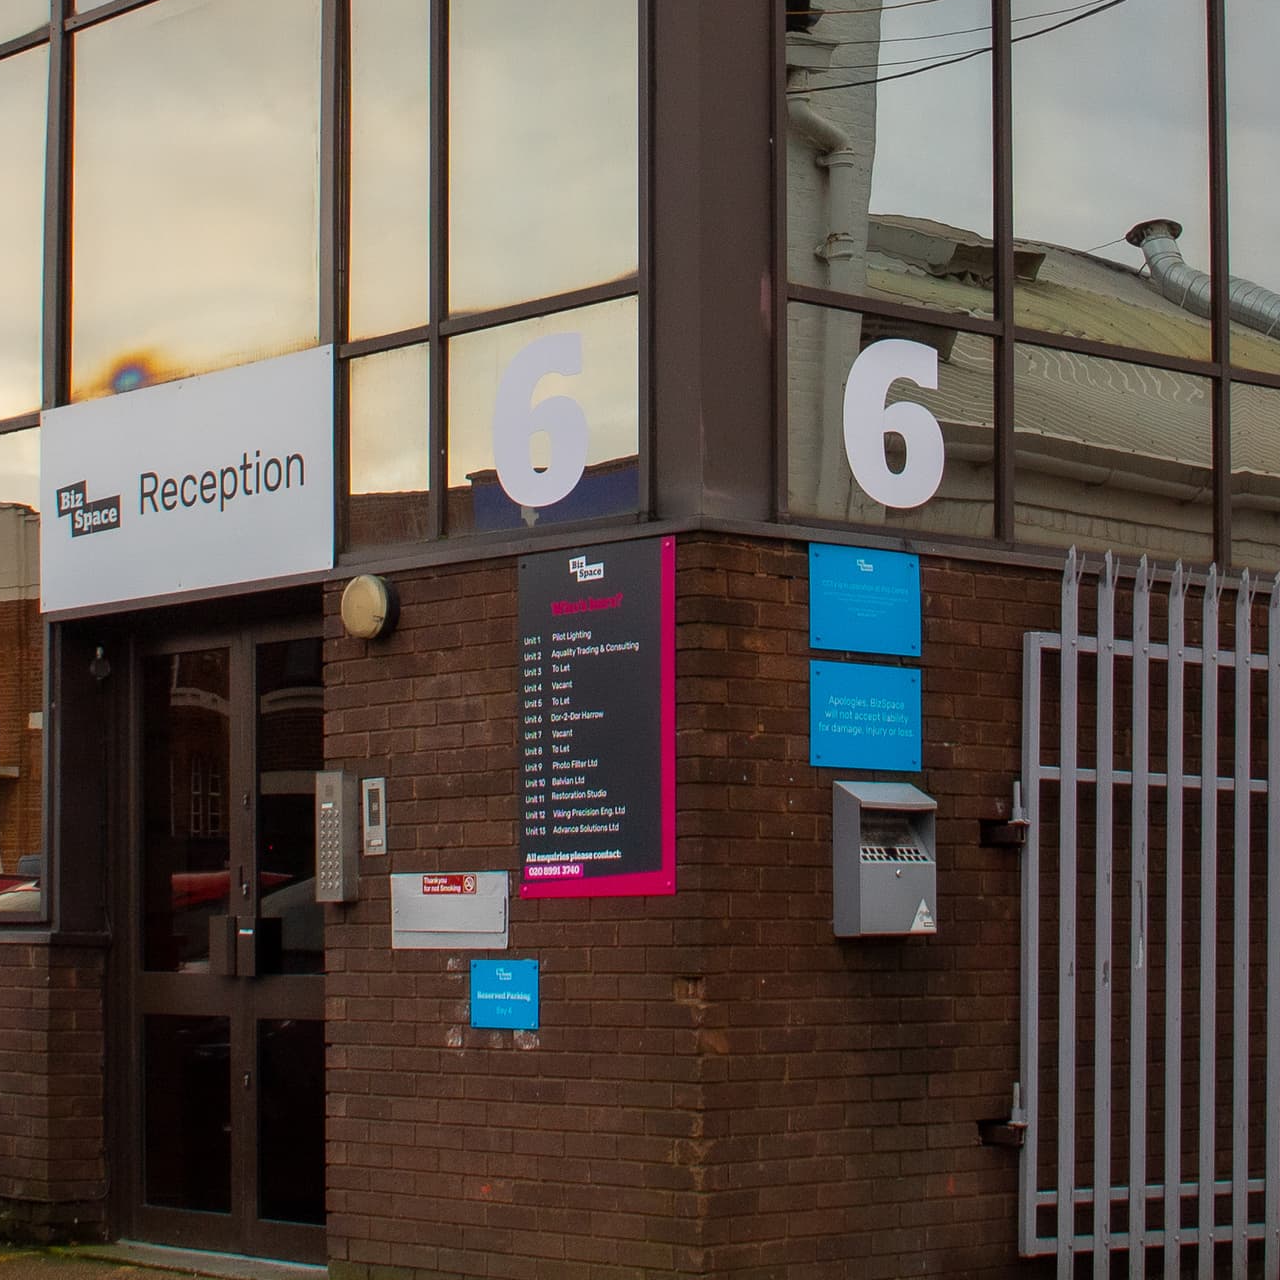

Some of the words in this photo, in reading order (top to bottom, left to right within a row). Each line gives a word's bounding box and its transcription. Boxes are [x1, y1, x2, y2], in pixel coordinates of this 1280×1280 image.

[493, 331, 589, 508] 6
[842, 338, 945, 508] 6
[139, 450, 306, 515] Reception
[60, 489, 83, 511] Biz
[74, 506, 118, 531] Space
[578, 567, 603, 579] Space
[523, 636, 537, 646] Unit
[552, 632, 566, 641] Pilot
[566, 630, 592, 642] Lighting
[523, 652, 537, 661] Unit
[577, 645, 599, 655] Trading
[605, 640, 640, 652] Consulting
[524, 668, 537, 677] Unit
[552, 664, 559, 673] To
[560, 663, 571, 672] Let
[524, 684, 537, 693] Unit
[551, 680, 573, 690] Vacant
[524, 700, 537, 709] Unit
[552, 697, 559, 706] To
[560, 696, 570, 705] Let
[524, 715, 537, 724] Unit
[839, 710, 852, 720] not
[854, 712, 881, 722] accept
[524, 731, 537, 740] Unit
[551, 729, 573, 739] Vacant
[888, 728, 897, 736] or
[525, 747, 537, 756] Unit
[552, 744, 560, 754] To
[560, 744, 570, 753] Let
[525, 763, 537, 772] Unit
[552, 761, 570, 770] Photo
[587, 759, 598, 768] Ltd
[525, 779, 538, 788] Unit
[574, 776, 585, 784] Ltd
[525, 795, 538, 804] Unit
[586, 789, 607, 798] Studio
[525, 811, 538, 819] Unit
[571, 808, 600, 817] Precision
[614, 806, 626, 815] Ltd
[525, 827, 538, 836] Unit
[552, 825, 579, 834] Advance
[579, 824, 608, 833] Solutions
[608, 822, 620, 832] Ltd
[526, 852, 537, 862] All
